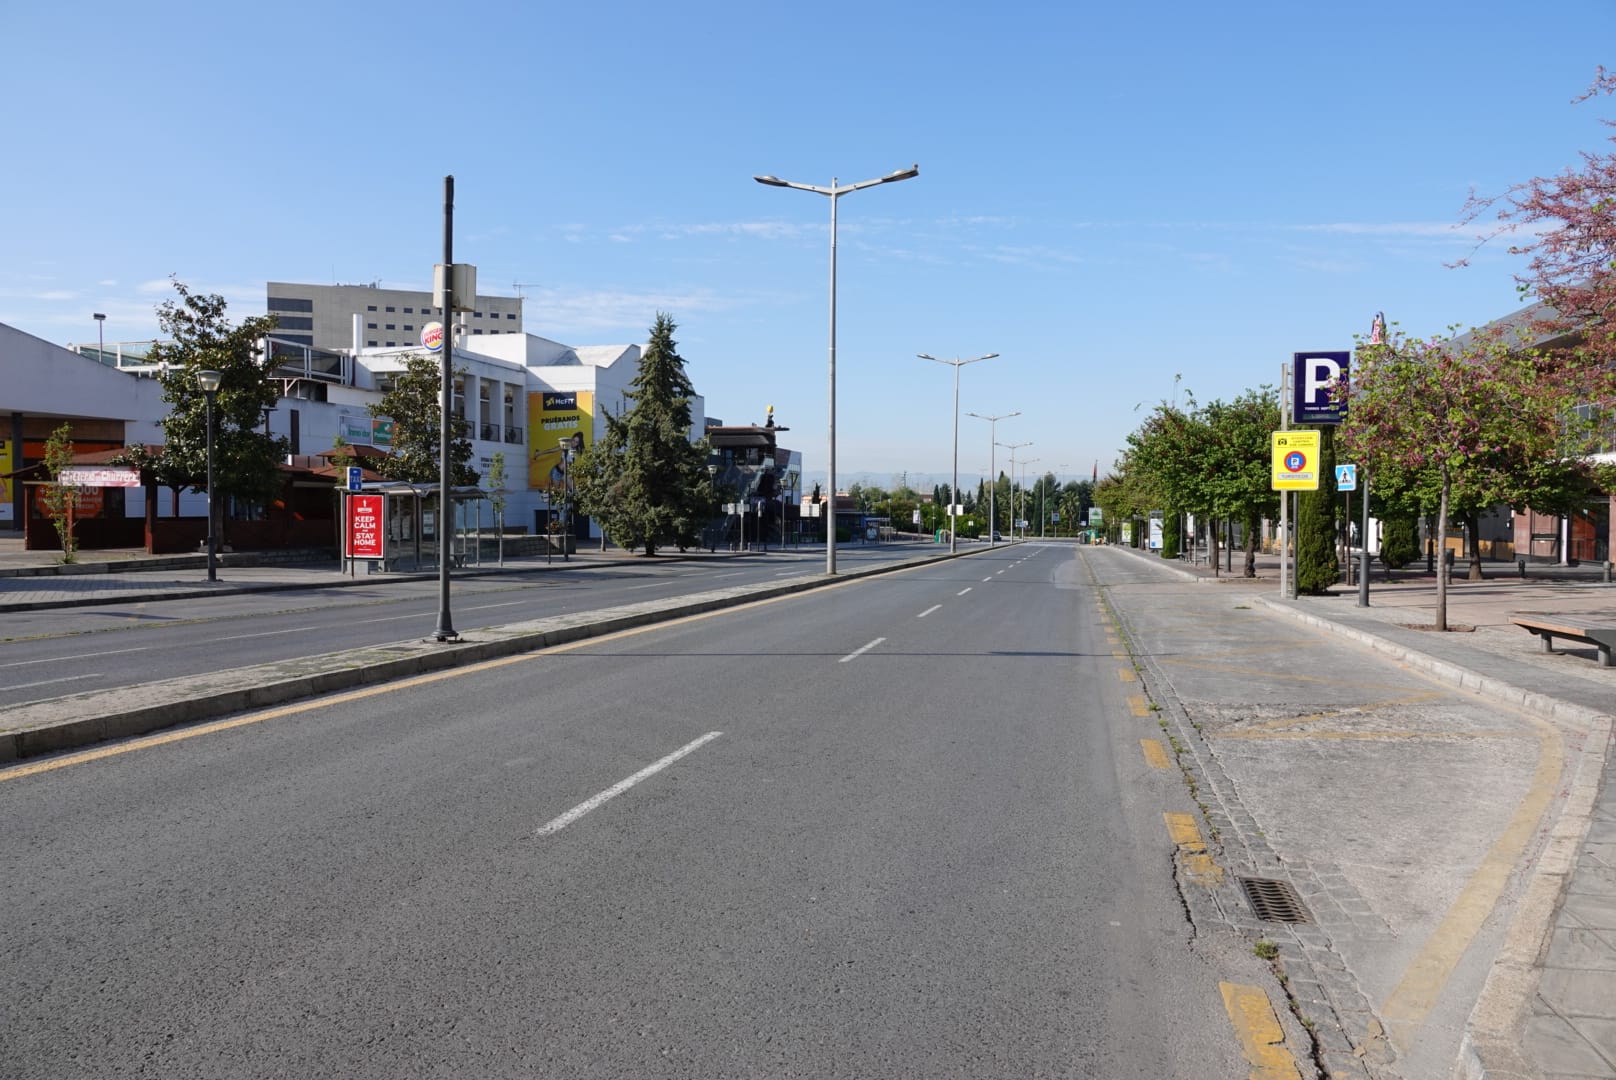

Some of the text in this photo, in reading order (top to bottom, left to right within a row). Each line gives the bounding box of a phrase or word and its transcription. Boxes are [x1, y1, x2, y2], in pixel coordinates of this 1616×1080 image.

[424, 332, 443, 344] KING
[1305, 358, 1340, 403] P
[543, 421, 578, 430] GRATIS
